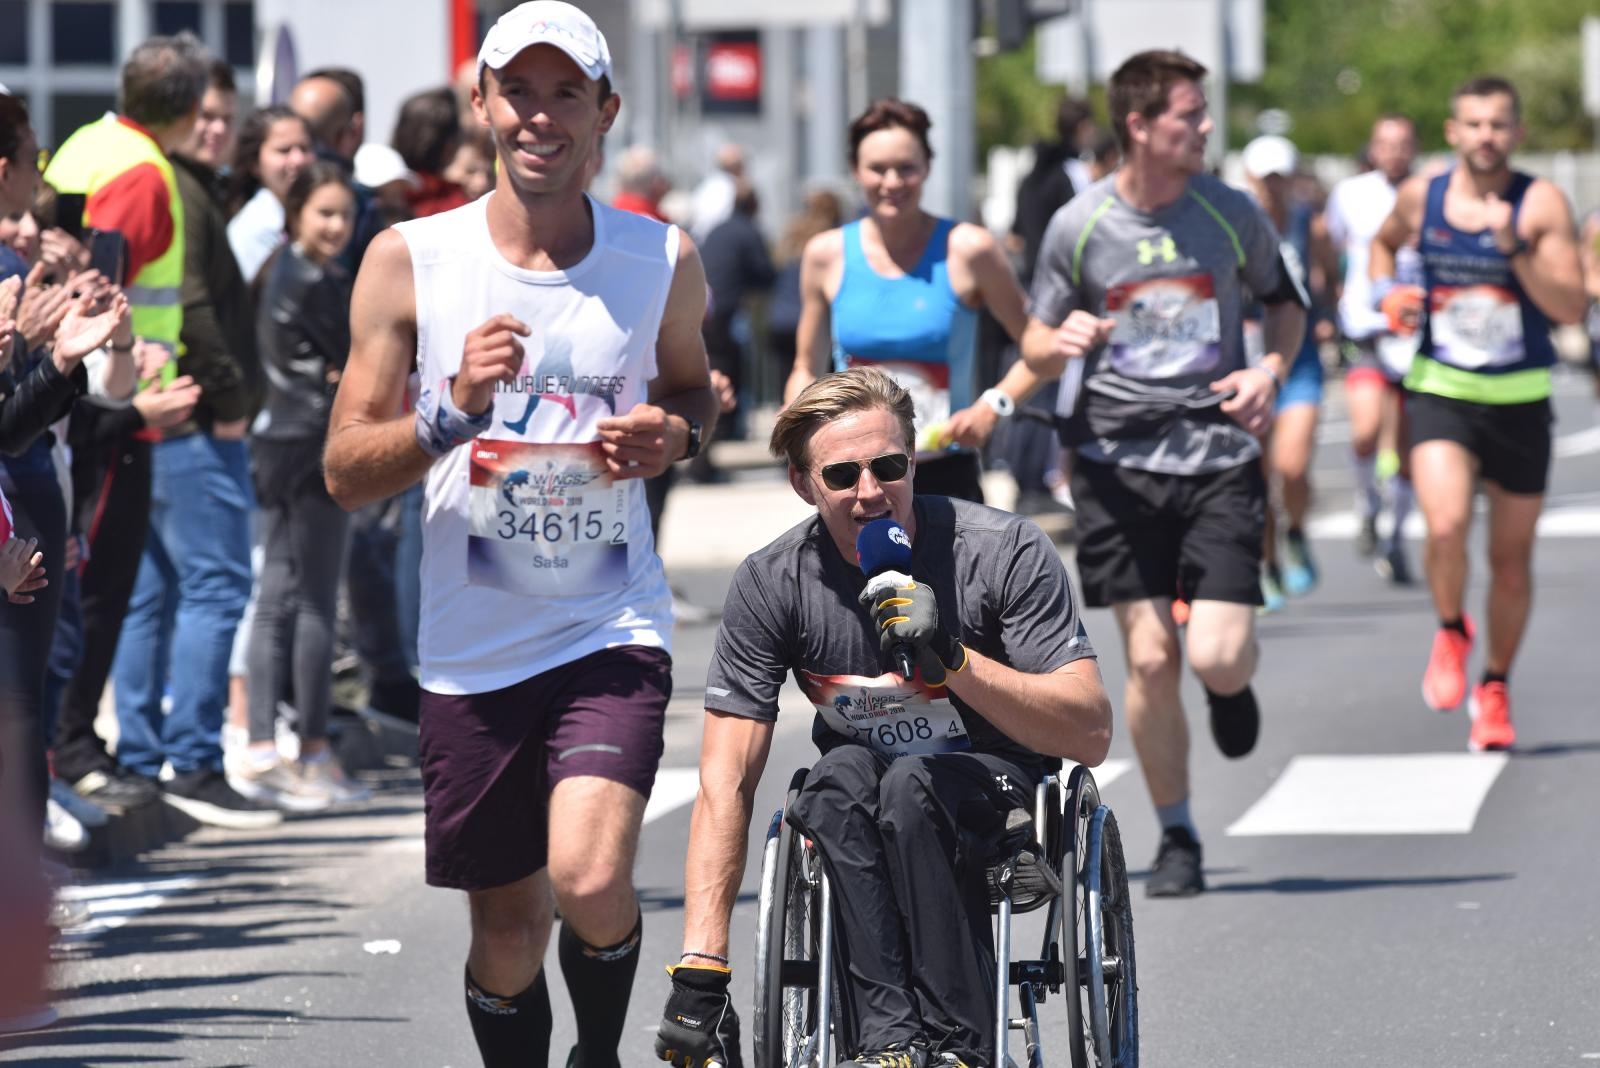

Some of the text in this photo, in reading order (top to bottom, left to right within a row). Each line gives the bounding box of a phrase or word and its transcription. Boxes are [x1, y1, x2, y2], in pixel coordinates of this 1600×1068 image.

[533, 474, 583, 486] WINGS
[538, 485, 567, 496] LIFE
[497, 510, 603, 542] 34615
[612, 521, 625, 543] 2
[533, 555, 569, 569] Saša
[853, 694, 896, 706] WINGS
[863, 702, 888, 713] LIFE
[849, 713, 874, 721] WORLD
[873, 709, 889, 718] RUN
[948, 720, 960, 734] 4
